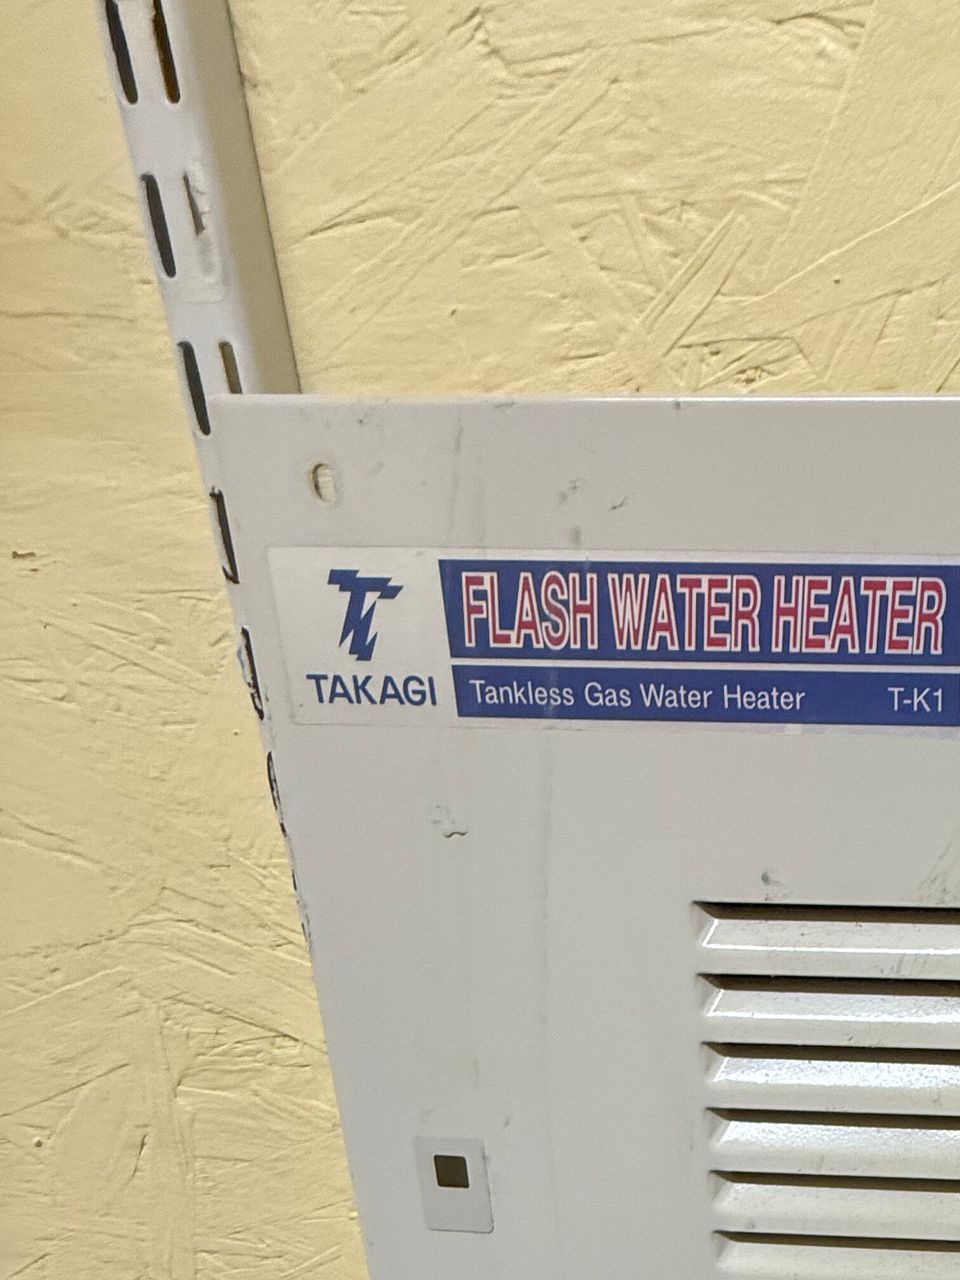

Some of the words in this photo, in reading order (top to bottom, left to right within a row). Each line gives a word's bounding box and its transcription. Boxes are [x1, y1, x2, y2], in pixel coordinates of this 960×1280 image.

[461, 571, 597, 650] FLASH
[607, 572, 760, 652] WATER
[771, 574, 947, 655] HEATER
[306, 673, 436, 707] TAKAGI
[470, 679, 573, 706] Tankless
[585, 682, 631, 708] Gas
[641, 683, 711, 710] Water
[723, 683, 805, 711] Heater
[888, 687, 945, 713] T-K1
